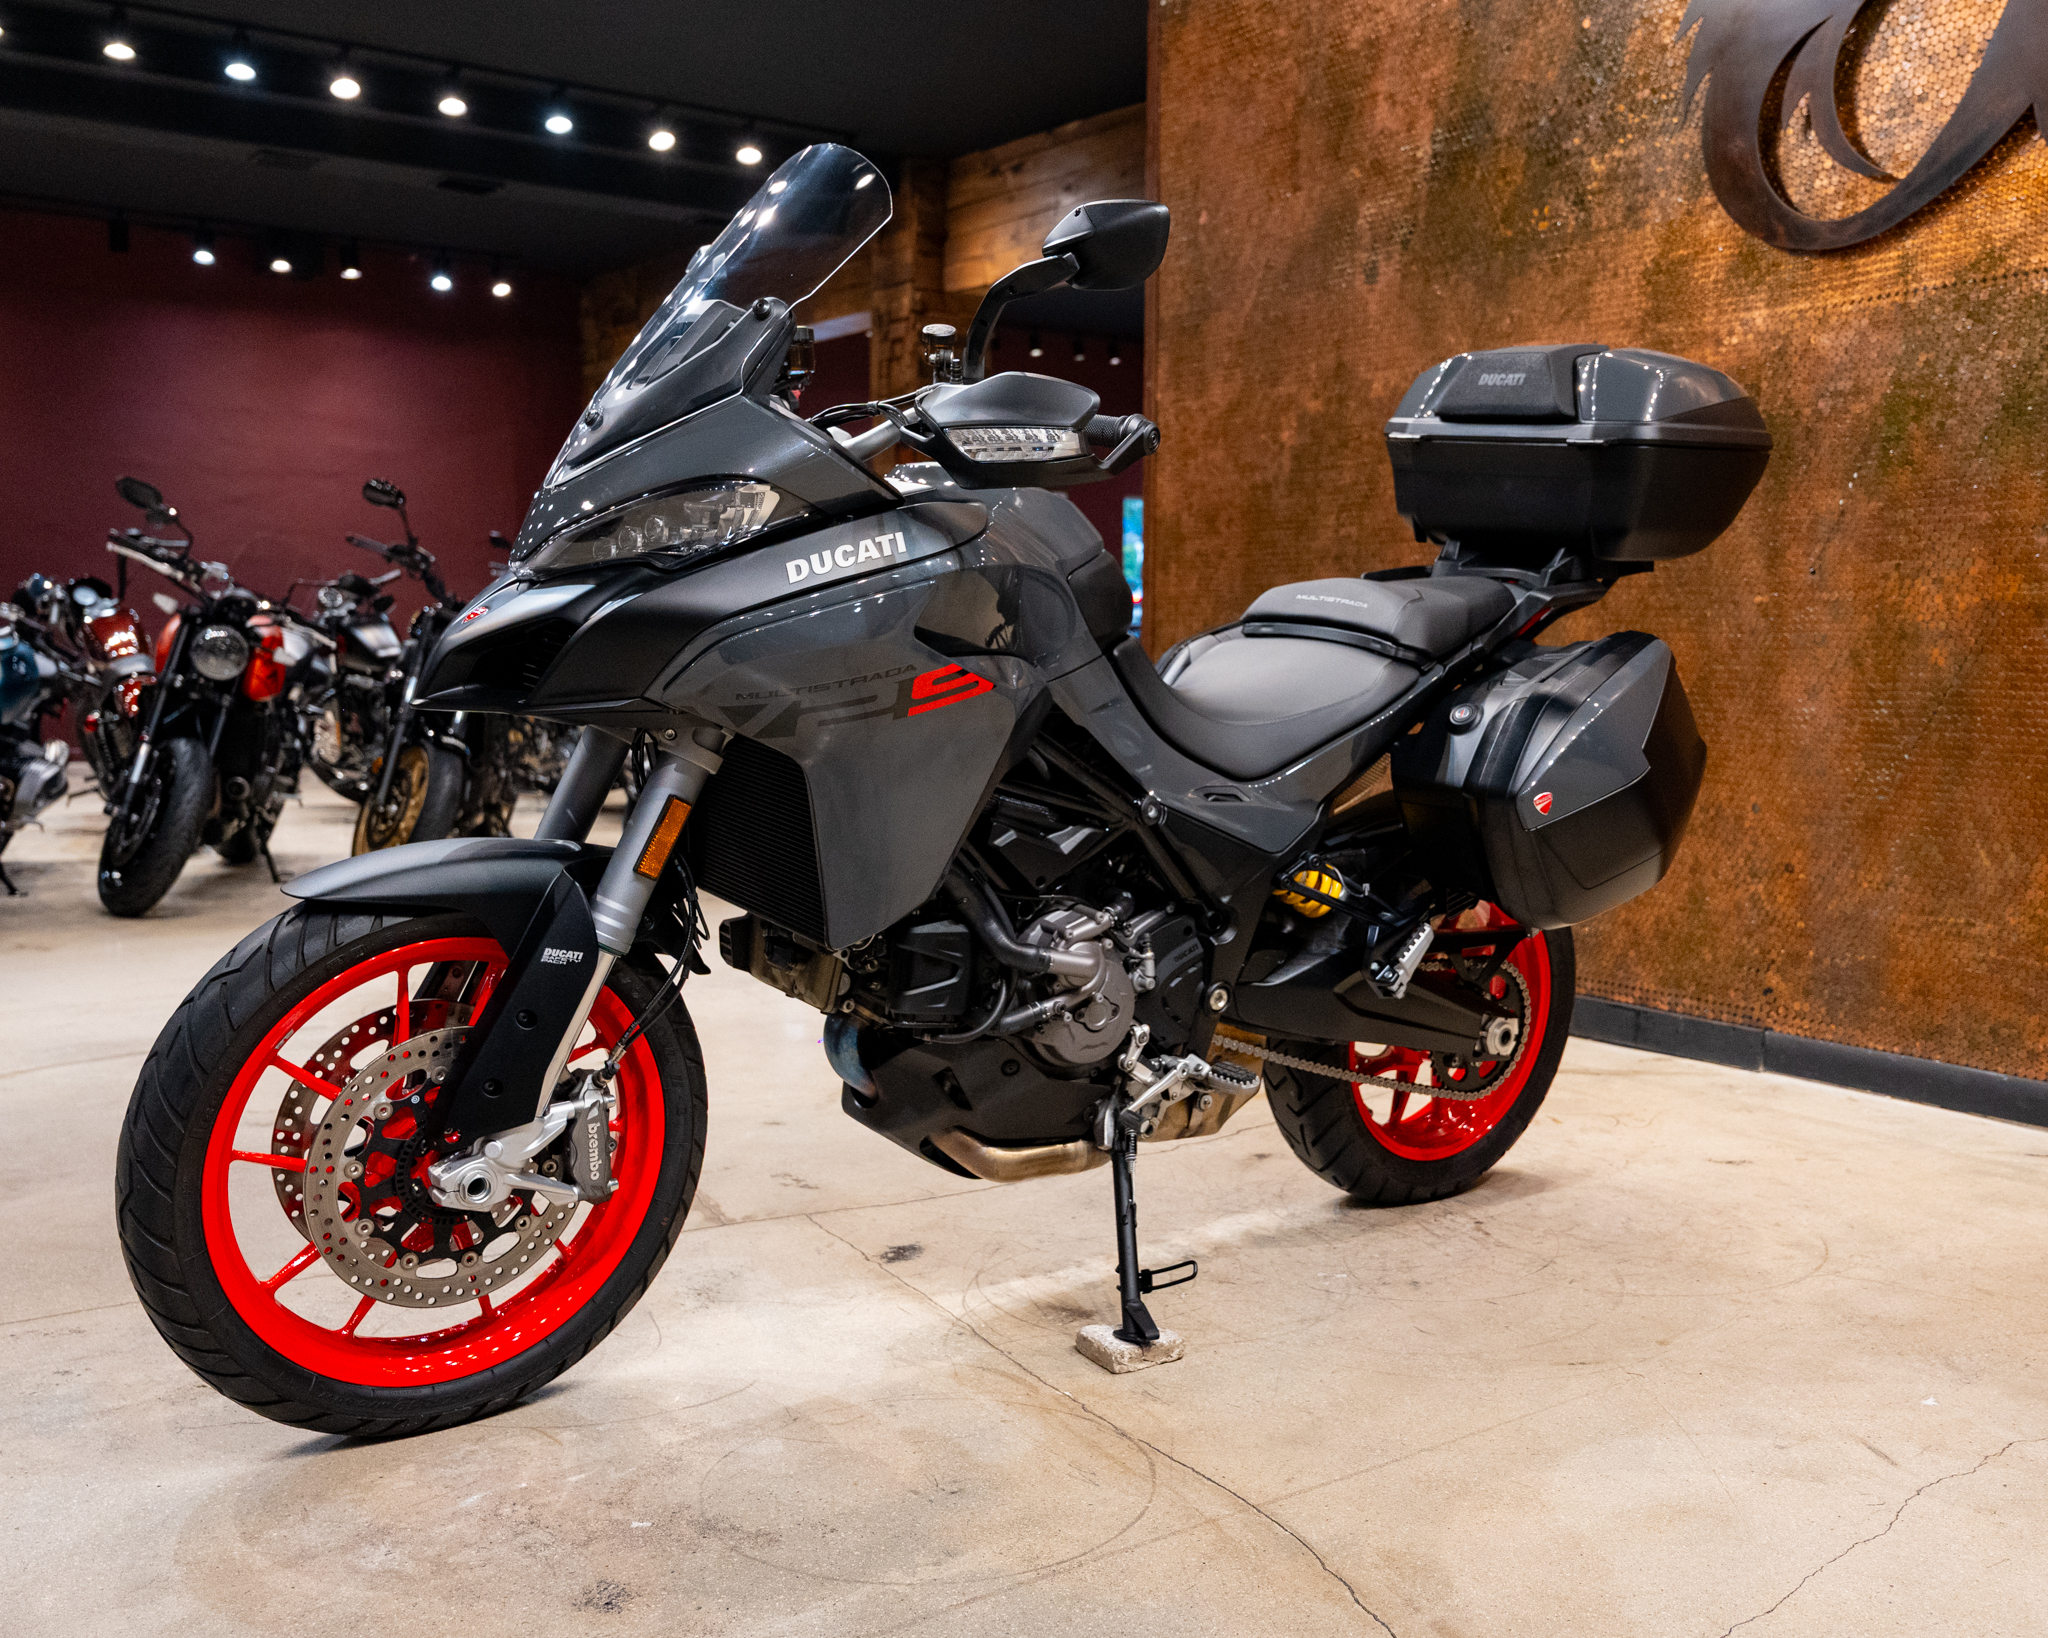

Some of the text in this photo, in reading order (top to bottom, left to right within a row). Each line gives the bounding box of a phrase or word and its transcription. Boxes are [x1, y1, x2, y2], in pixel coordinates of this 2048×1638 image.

[1478, 373, 1526, 386] DUCATI
[785, 531, 908, 584] DUCATI
[1295, 593, 1368, 609] MULTISTRADA
[735, 663, 917, 700] MULTISTRADA
[543, 947, 584, 960] DUCATI
[587, 1122, 601, 1181] brembo
